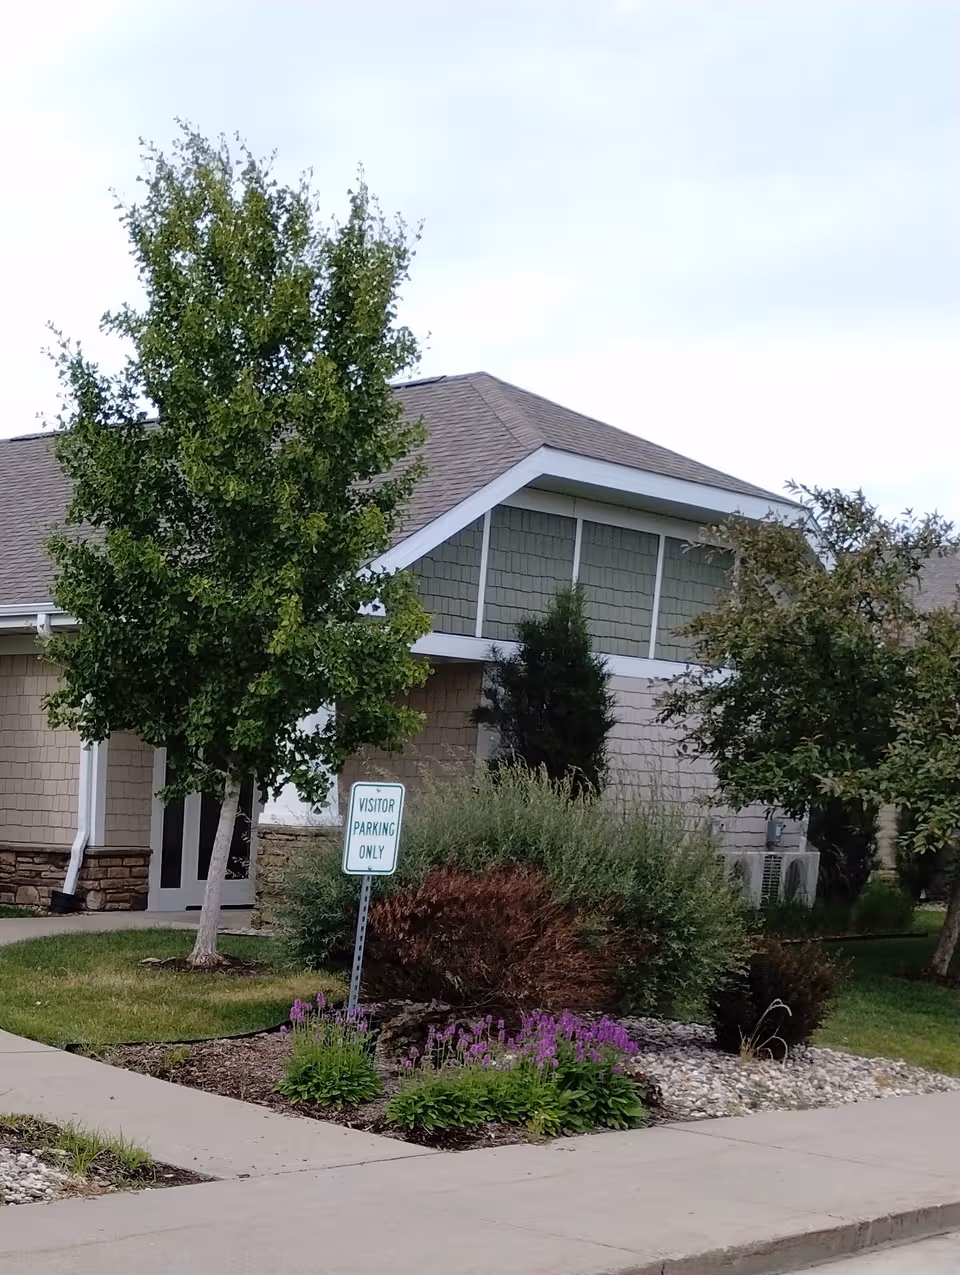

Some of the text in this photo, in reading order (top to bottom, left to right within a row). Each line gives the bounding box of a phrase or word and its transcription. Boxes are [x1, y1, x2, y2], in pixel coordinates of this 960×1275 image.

[359, 797, 395, 813] VISITOR
[353, 821, 396, 836] PARKING
[359, 845, 385, 860] ONLY
